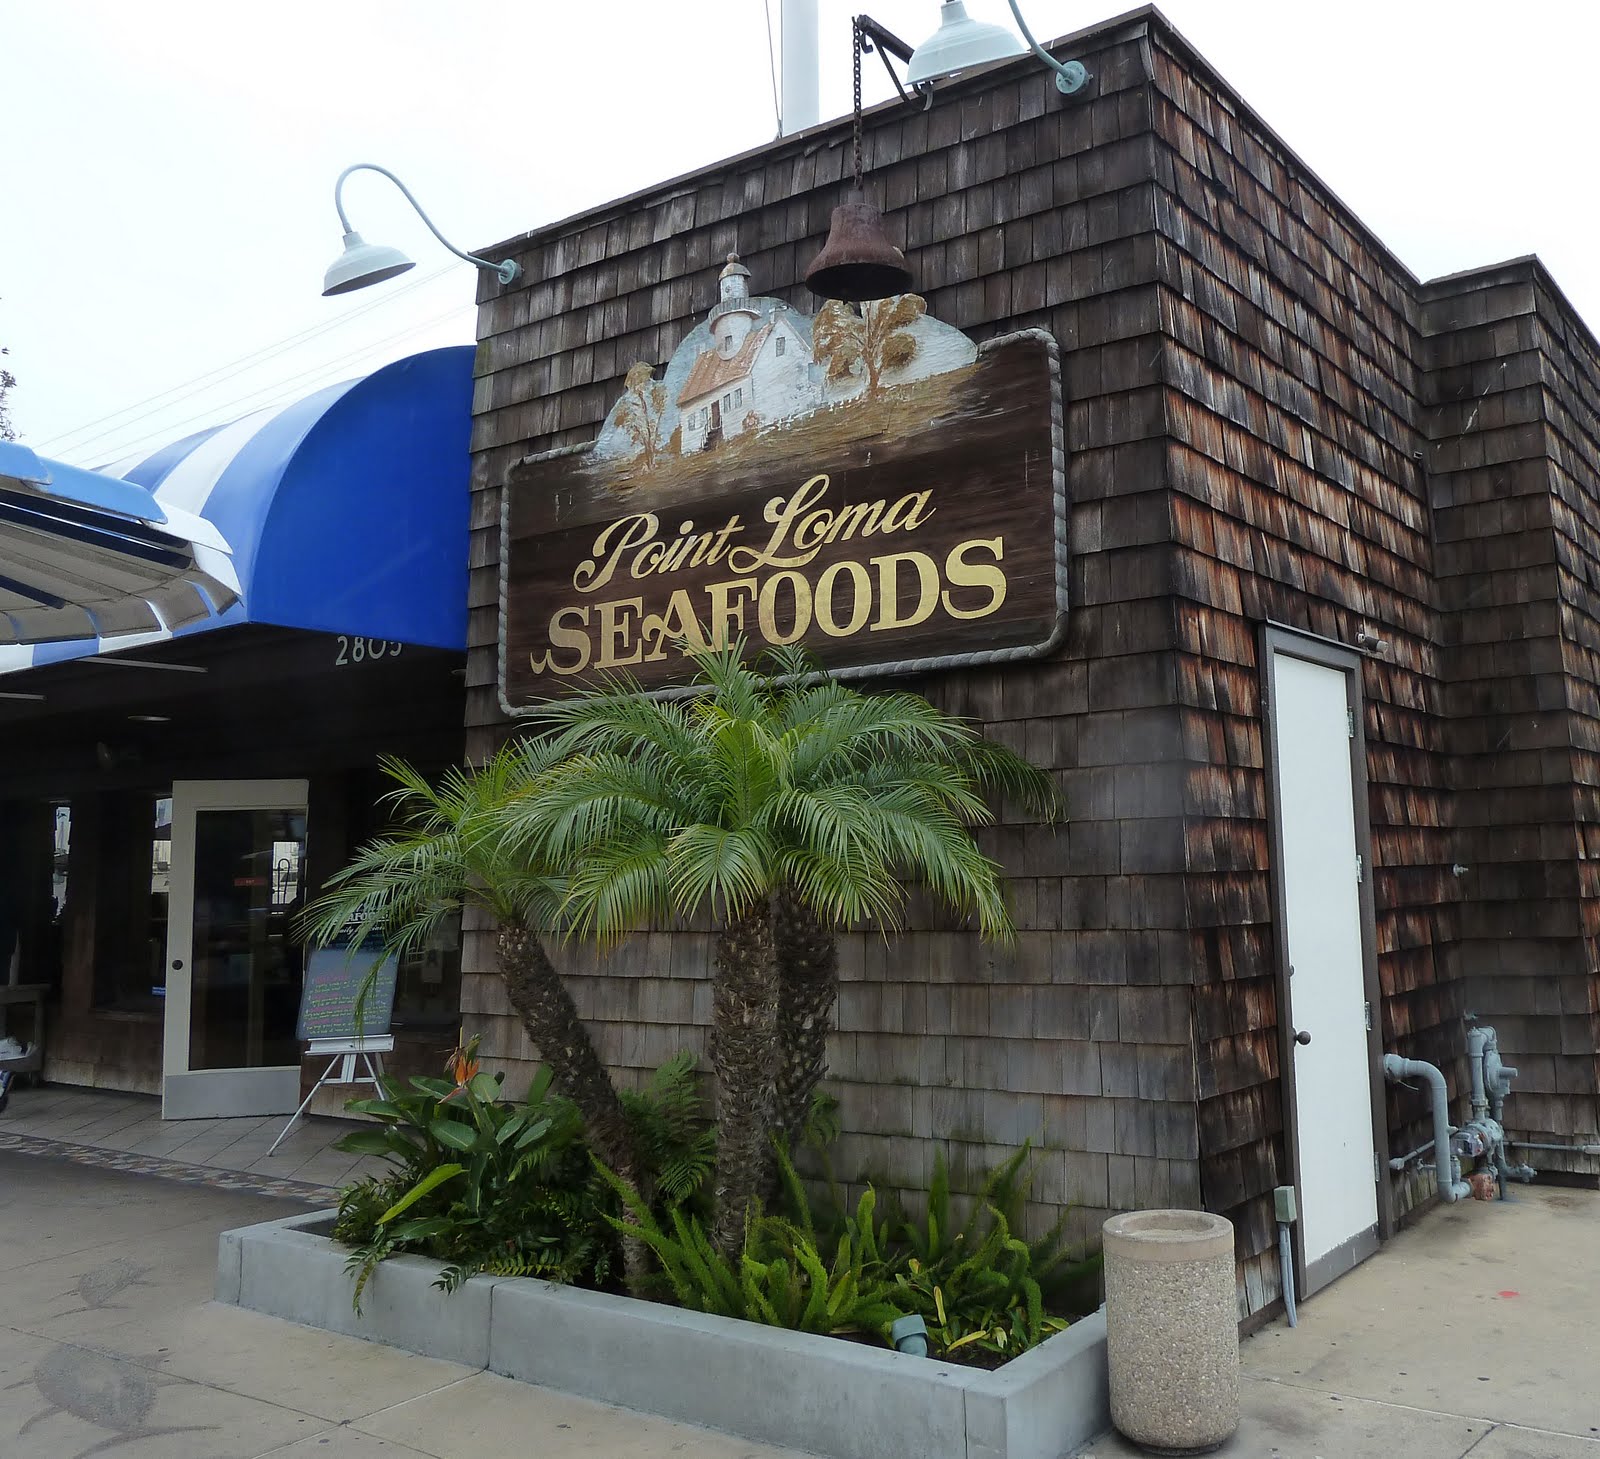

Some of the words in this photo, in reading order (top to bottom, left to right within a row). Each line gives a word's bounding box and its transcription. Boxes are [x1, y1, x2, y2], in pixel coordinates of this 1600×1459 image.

[573, 512, 745, 594] Point
[728, 474, 936, 574] Loma
[530, 537, 1008, 676] SEAFOODS
